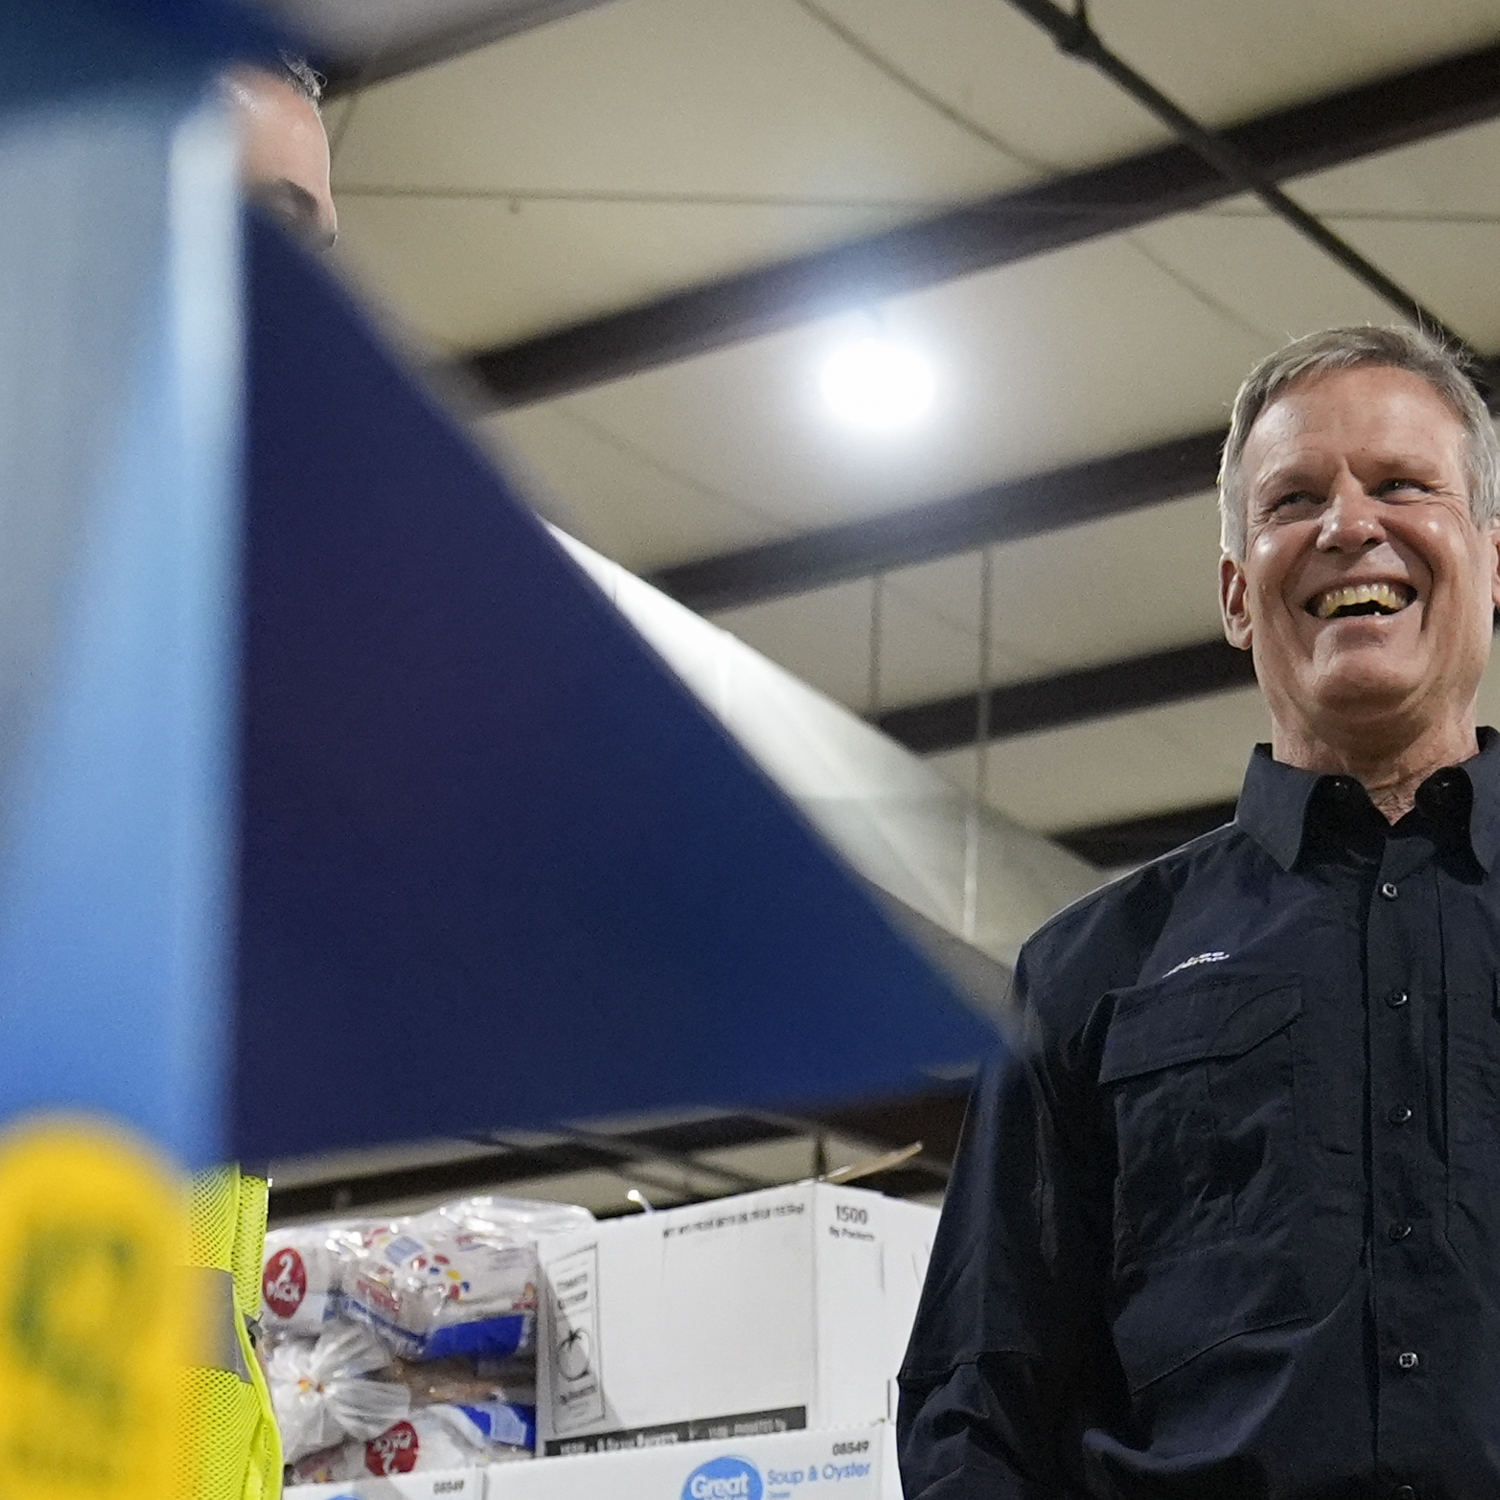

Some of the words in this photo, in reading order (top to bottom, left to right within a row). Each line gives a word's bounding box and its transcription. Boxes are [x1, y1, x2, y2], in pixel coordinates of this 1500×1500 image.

[835, 1204, 869, 1225] 1500
[277, 1254, 293, 1282] 2
[832, 1440, 870, 1456] 08549
[767, 1468, 804, 1486] Soup
[807, 1465, 818, 1480] &
[821, 1462, 871, 1483] Oyster
[690, 1473, 750, 1500] Great
